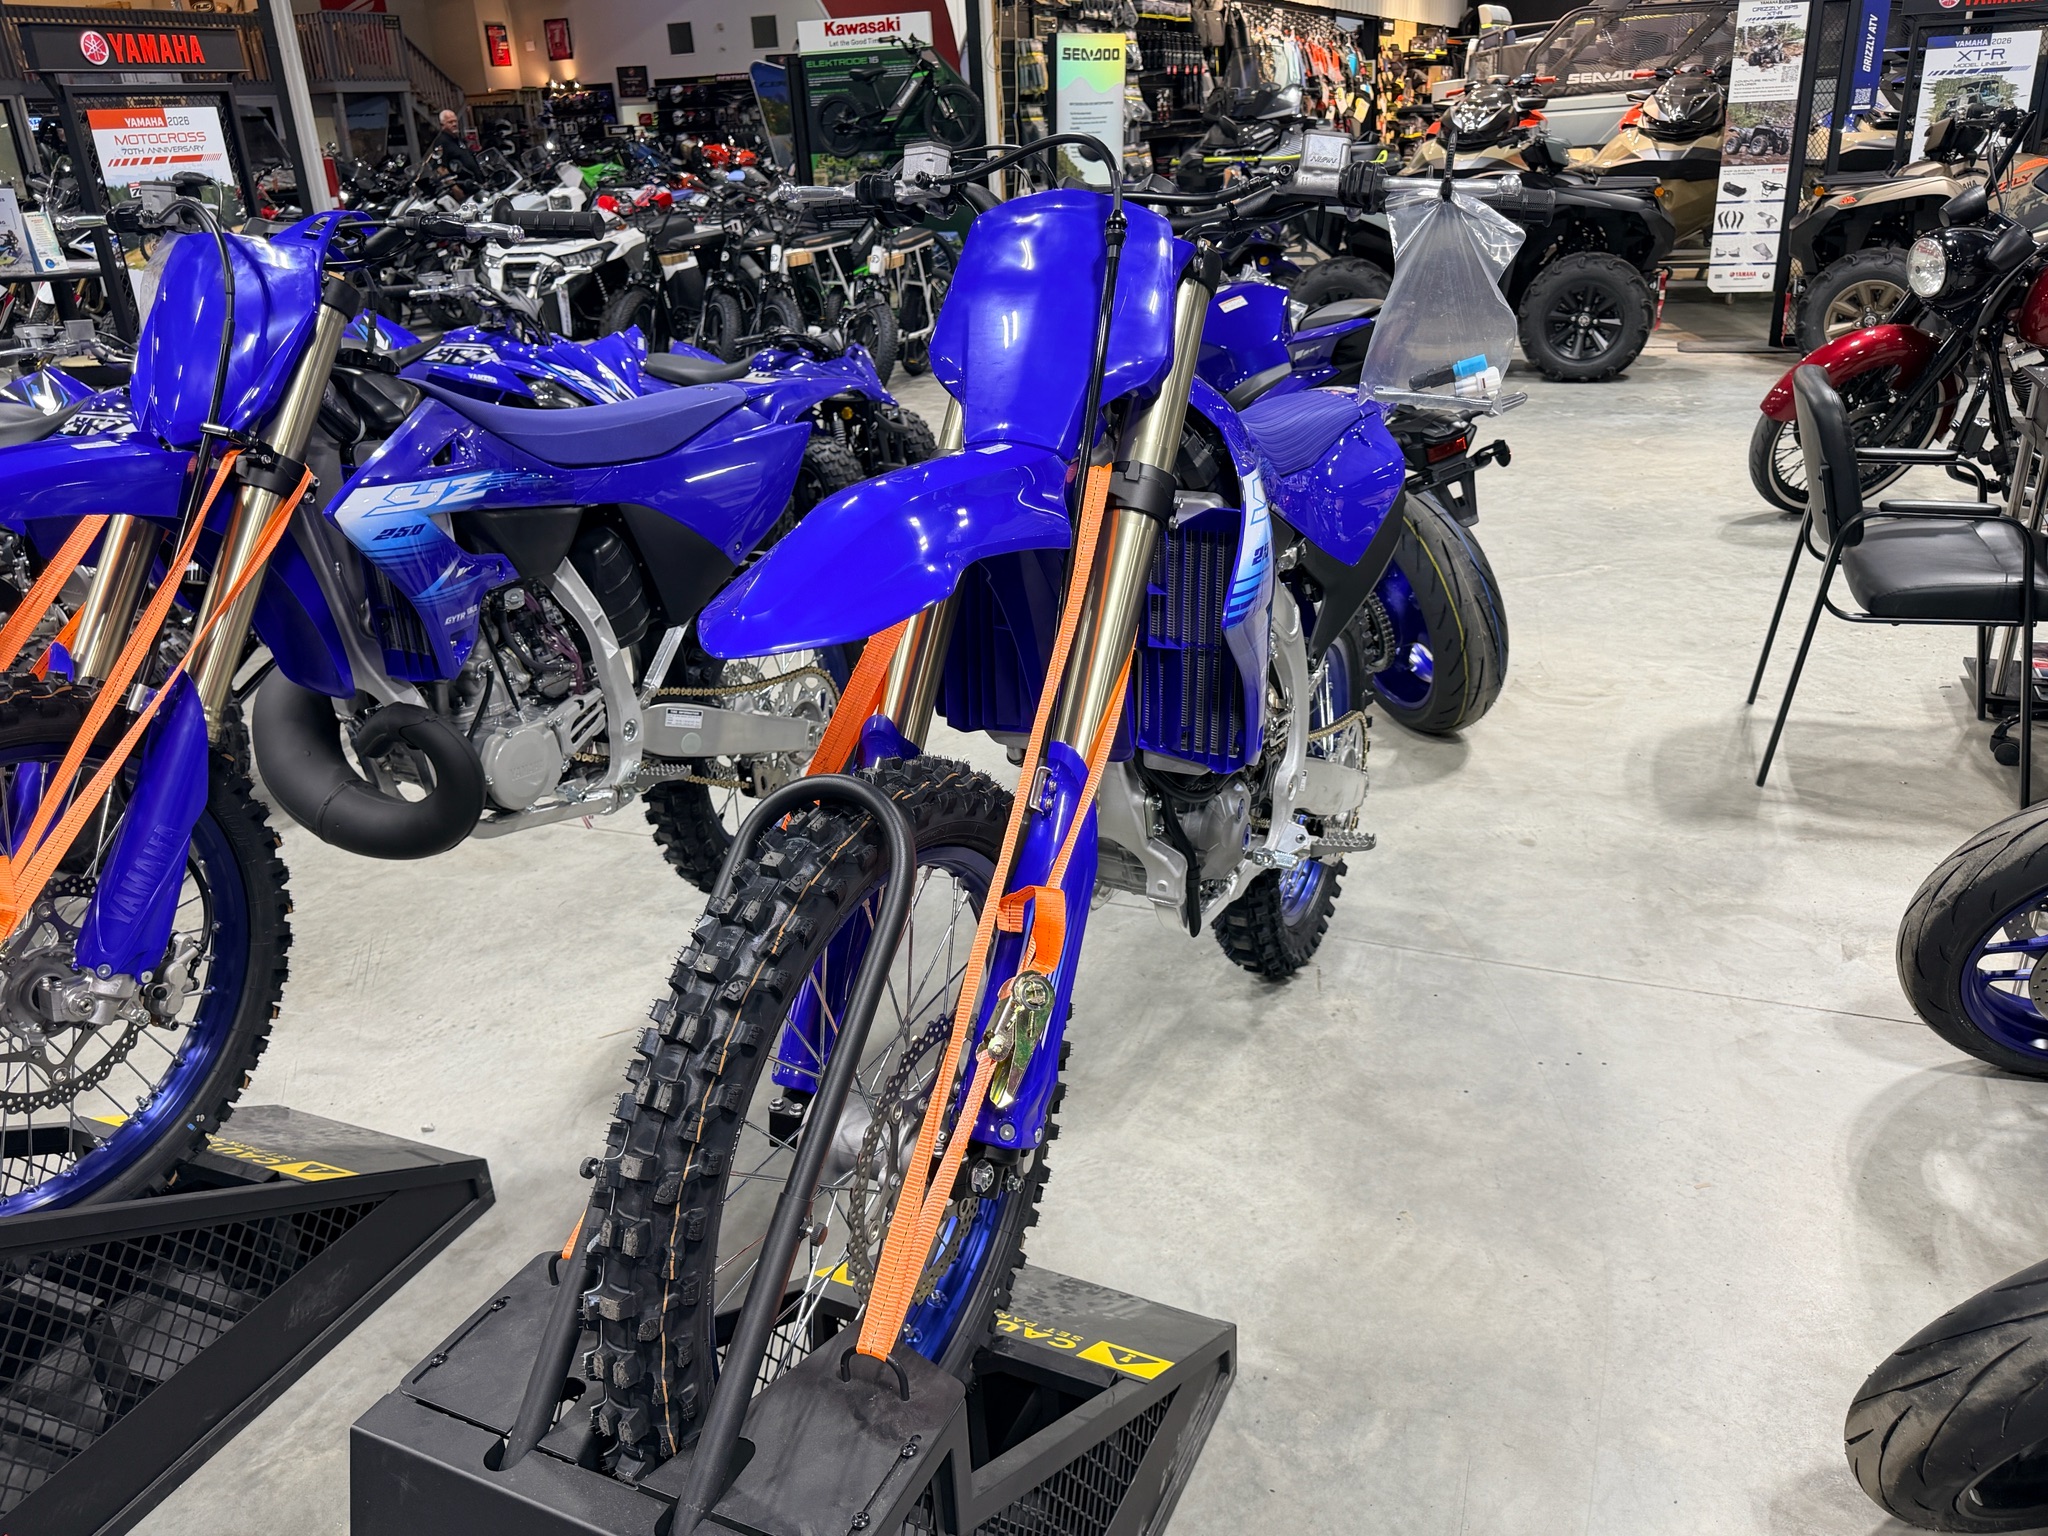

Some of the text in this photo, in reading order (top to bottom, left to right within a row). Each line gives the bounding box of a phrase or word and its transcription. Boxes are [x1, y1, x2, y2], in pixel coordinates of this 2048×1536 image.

[824, 16, 901, 37] Kawasaki
[106, 32, 206, 64] YAMAHA
[840, 39, 850, 47] the
[851, 38, 867, 46] Good
[1862, 13, 1879, 73] GRIZZLY ATV
[1955, 37, 2012, 47] YAMAHA 2026
[805, 57, 868, 68] ELEKTRODE
[1957, 48, 2006, 62] XT-R
[124, 116, 189, 128] YAMAHA 2026
[114, 131, 207, 146] MOTOCROSS
[121, 144, 205, 156] 70TH ANNIVERSARY
[372, 523, 427, 542] 250
[102, 824, 175, 924] YAMAHA
[1043, 1327, 1084, 1342] SET
